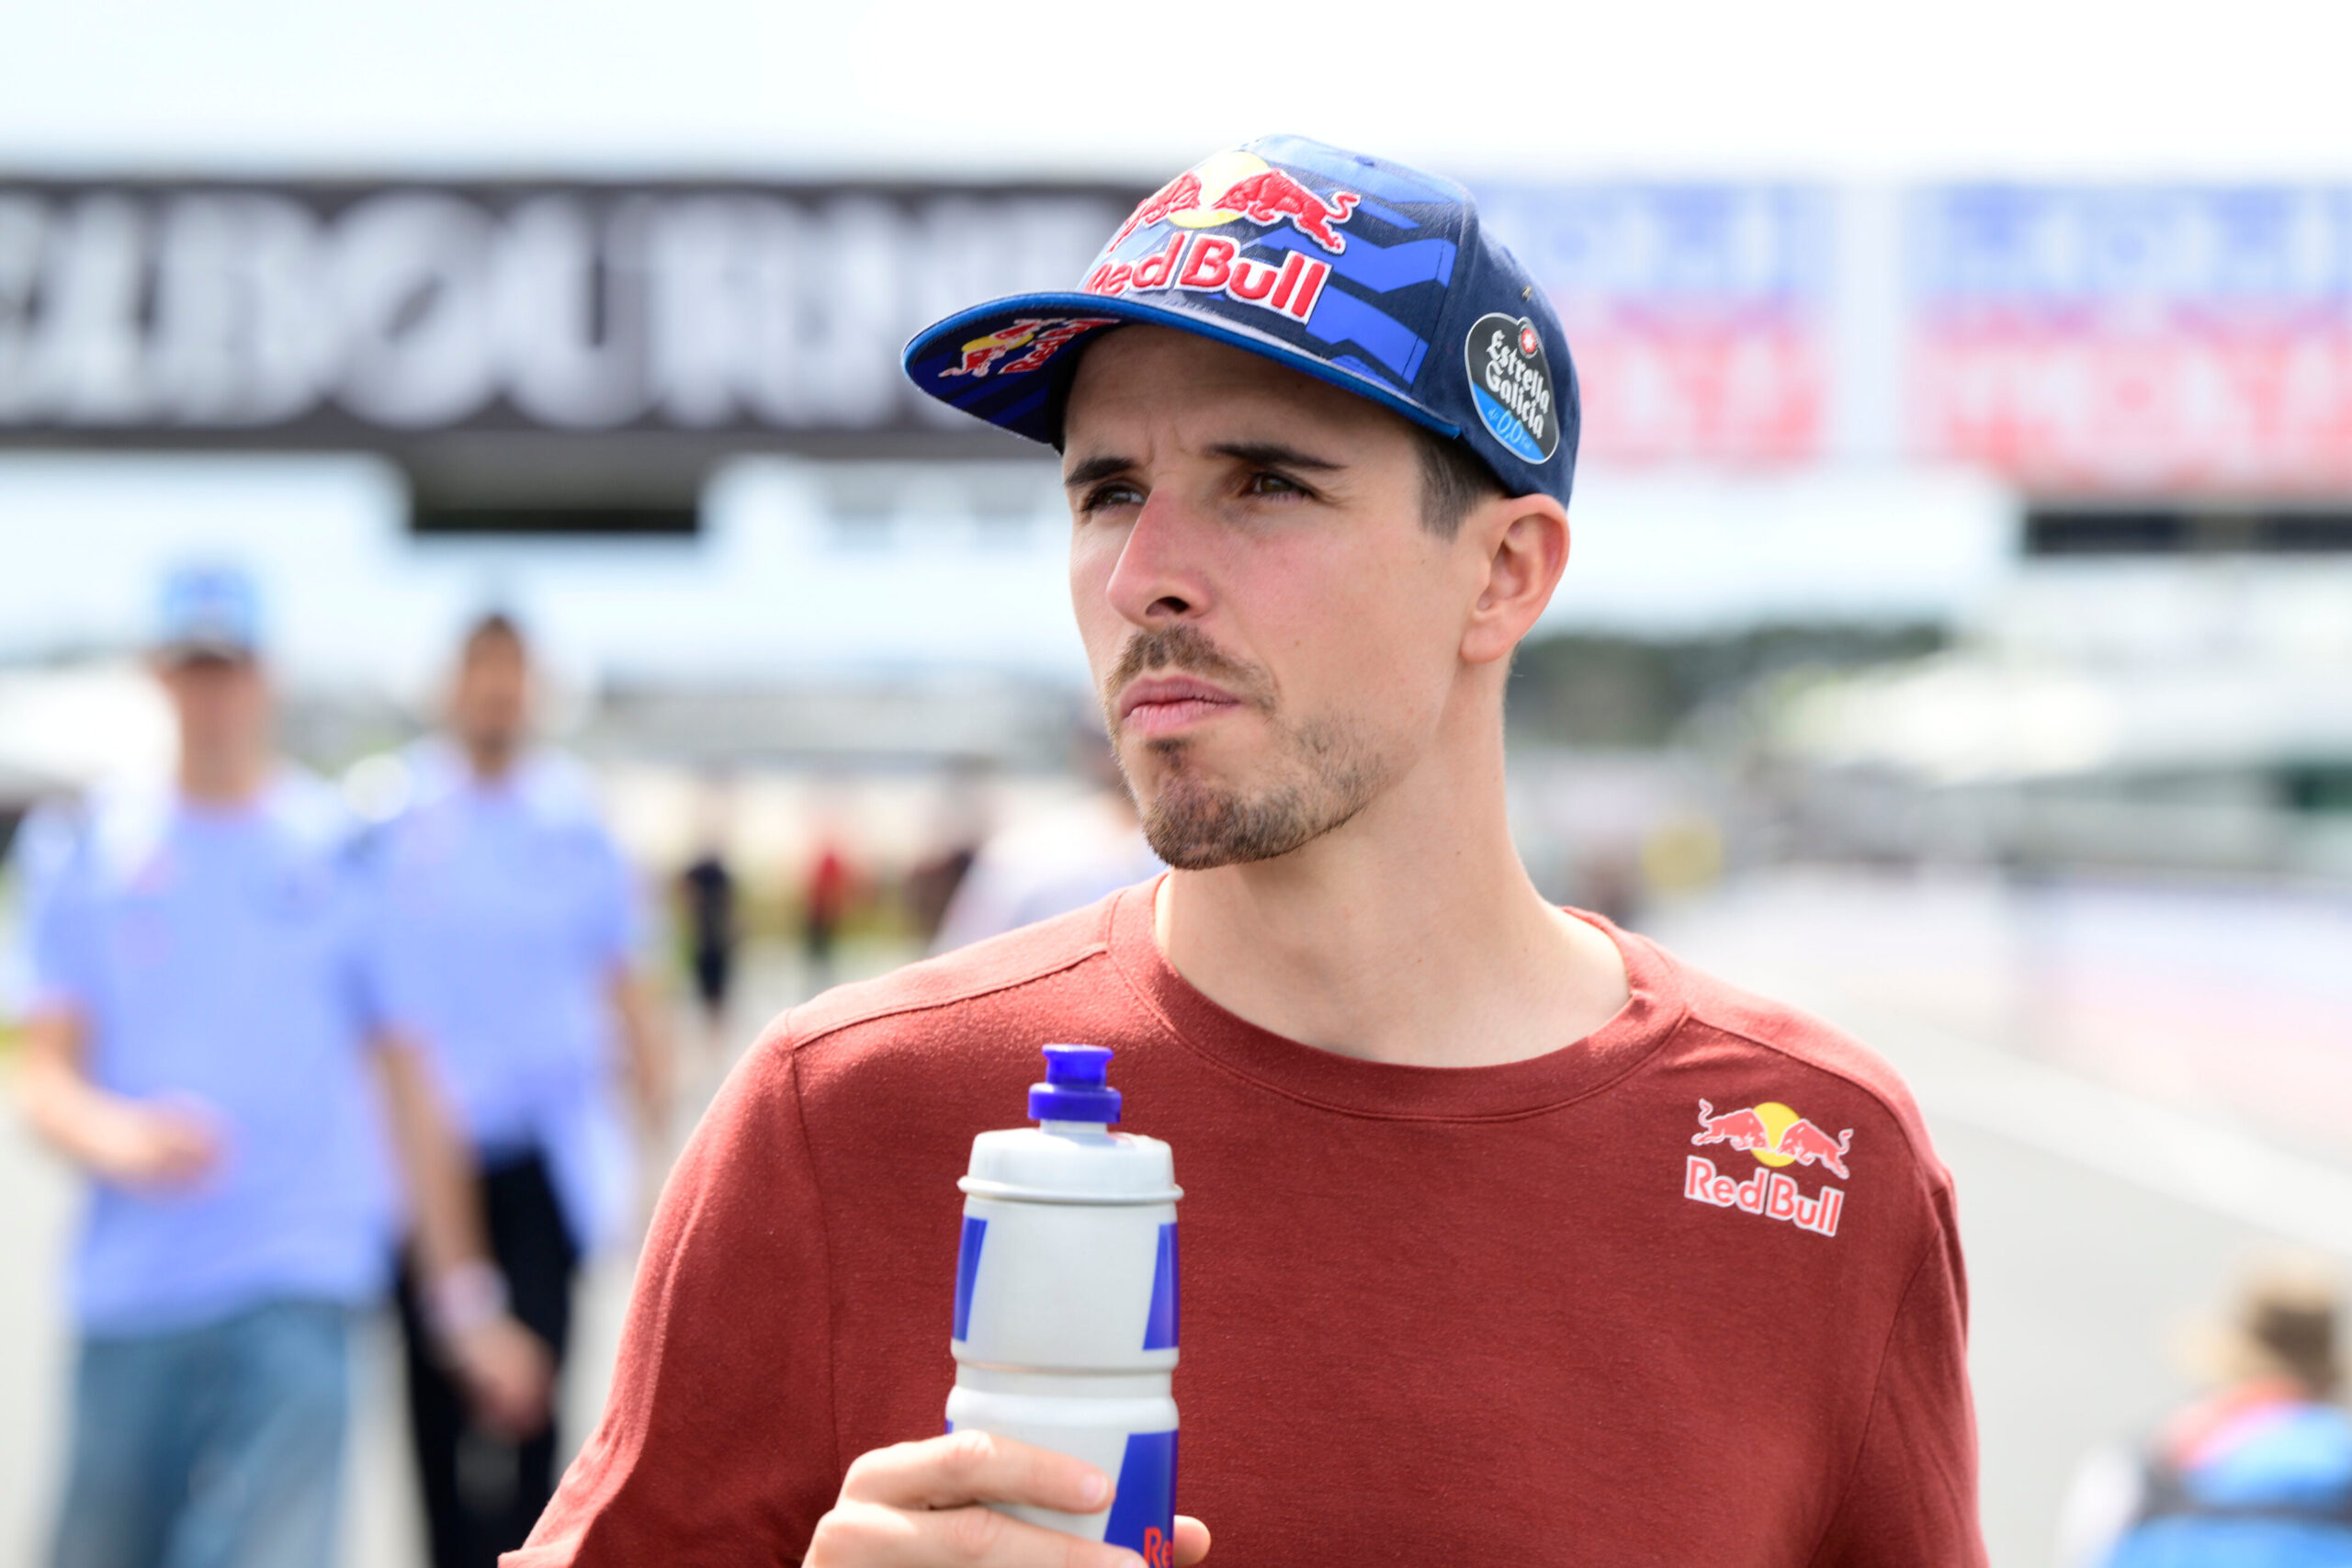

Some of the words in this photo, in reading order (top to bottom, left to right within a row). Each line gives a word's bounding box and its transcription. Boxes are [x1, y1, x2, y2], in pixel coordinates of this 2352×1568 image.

[1082, 231, 1191, 295] Red
[1175, 233, 1330, 323] Bull
[1486, 330, 1551, 414] Estrella
[1486, 360, 1544, 439] Galicia
[1685, 1156, 1769, 1213] Red
[1767, 1173, 1843, 1236] Bull
